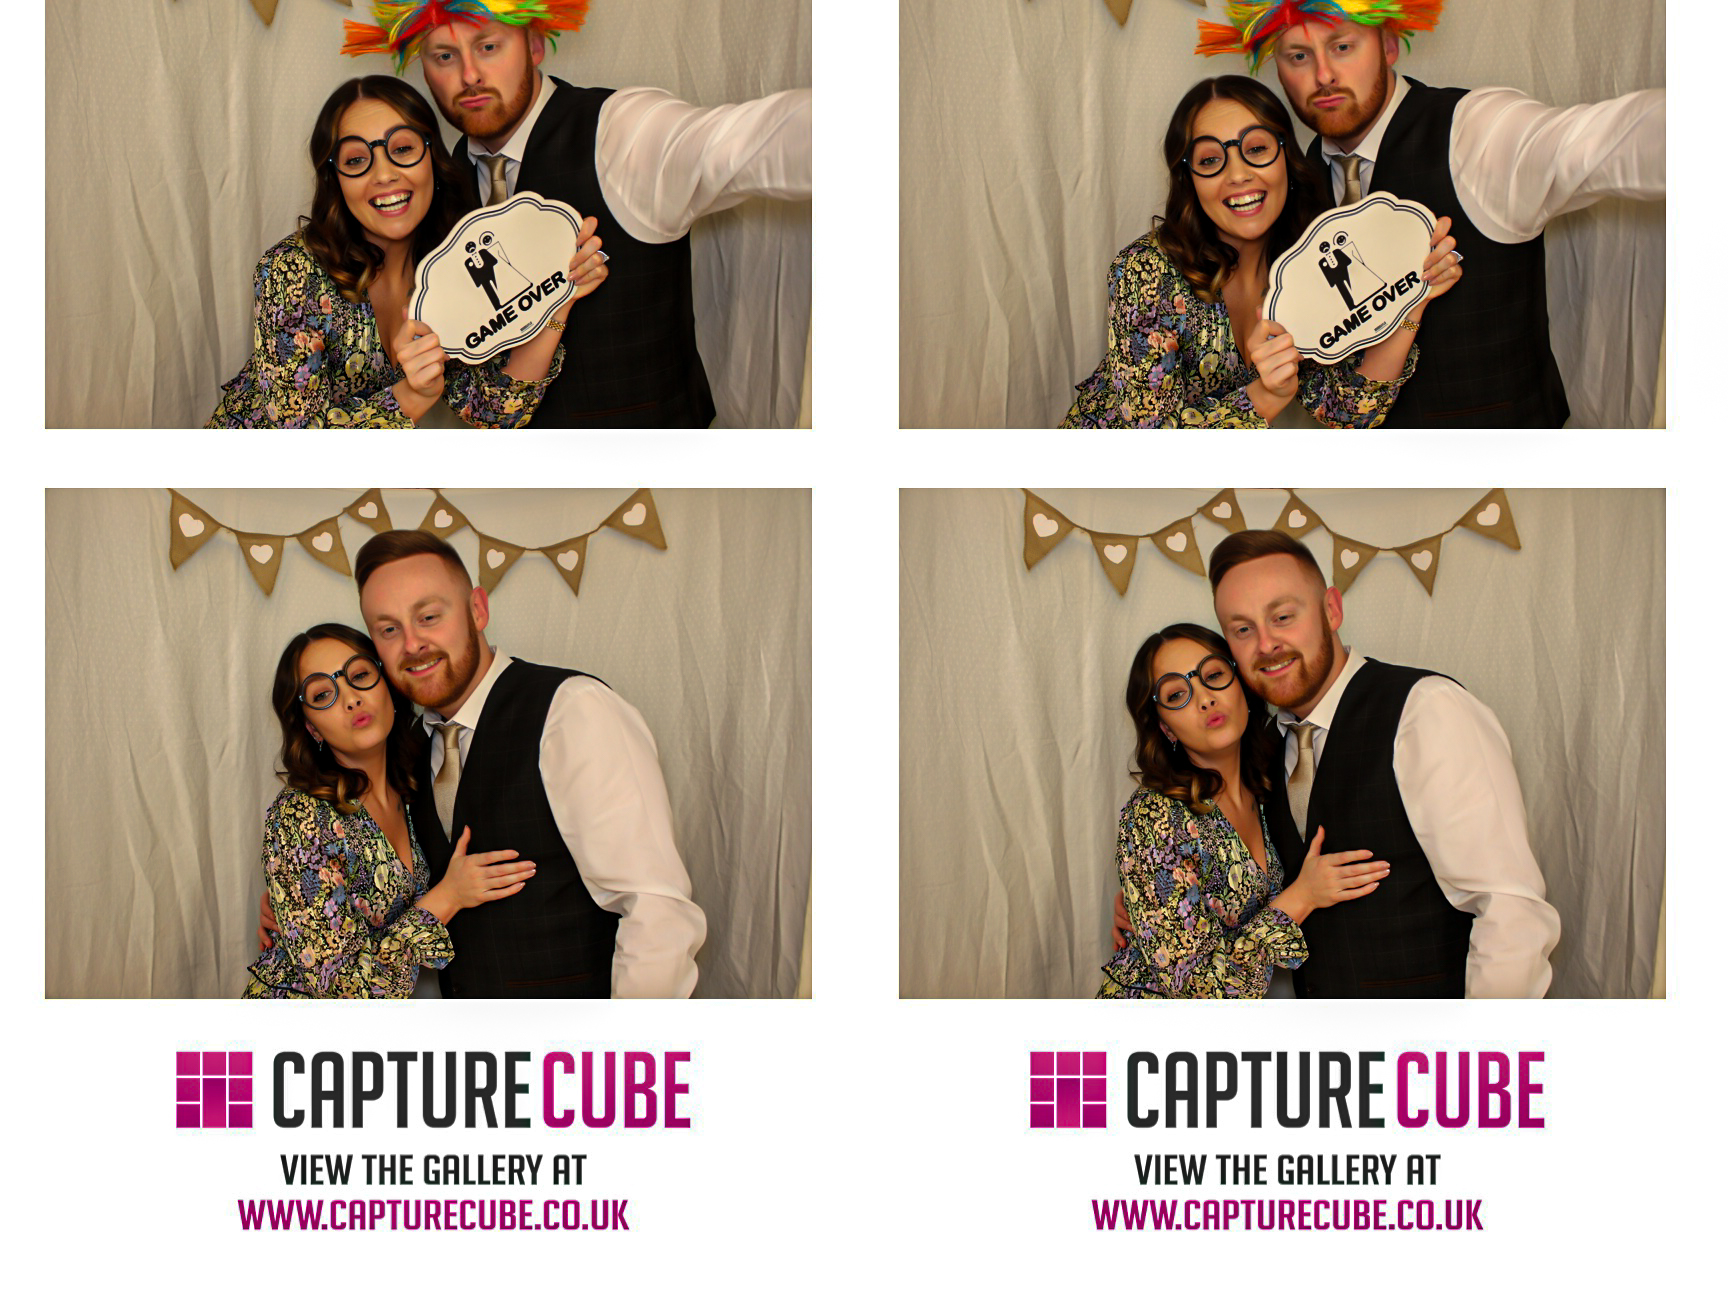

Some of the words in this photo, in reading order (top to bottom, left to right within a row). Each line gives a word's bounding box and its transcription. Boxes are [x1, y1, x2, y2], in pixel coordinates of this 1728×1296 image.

[465, 305, 518, 349] GAME
[518, 270, 567, 312] OVER
[1319, 305, 1372, 349] GAME
[1372, 270, 1421, 312] OVER
